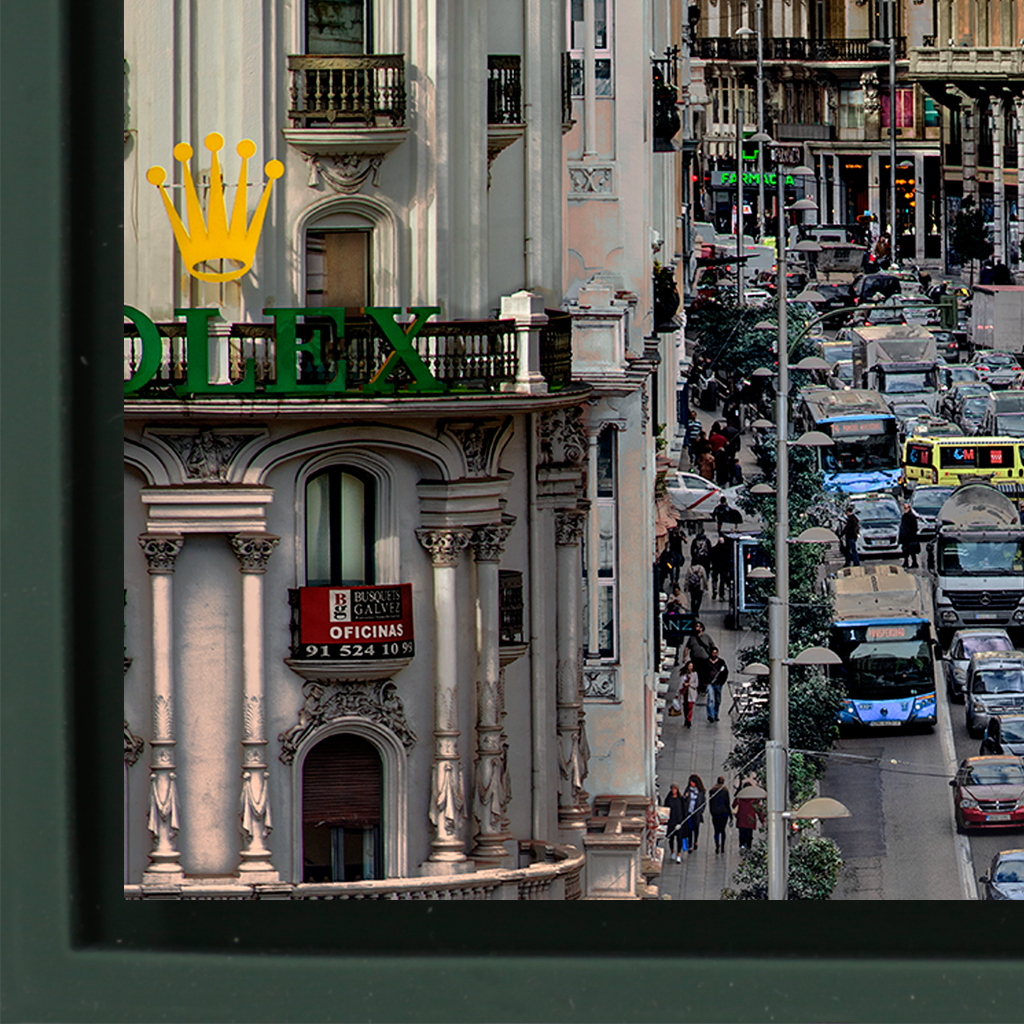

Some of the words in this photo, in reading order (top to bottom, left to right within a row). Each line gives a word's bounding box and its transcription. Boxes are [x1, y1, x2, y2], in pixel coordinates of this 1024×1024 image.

[721, 173, 795, 186] FARMACA
[354, 590, 400, 603] BUSQUETS
[329, 623, 403, 639] OFICINAS
[849, 629, 856, 641] 1
[305, 644, 331, 657] 91
[340, 644, 375, 657] 524
[381, 642, 399, 655] 10
